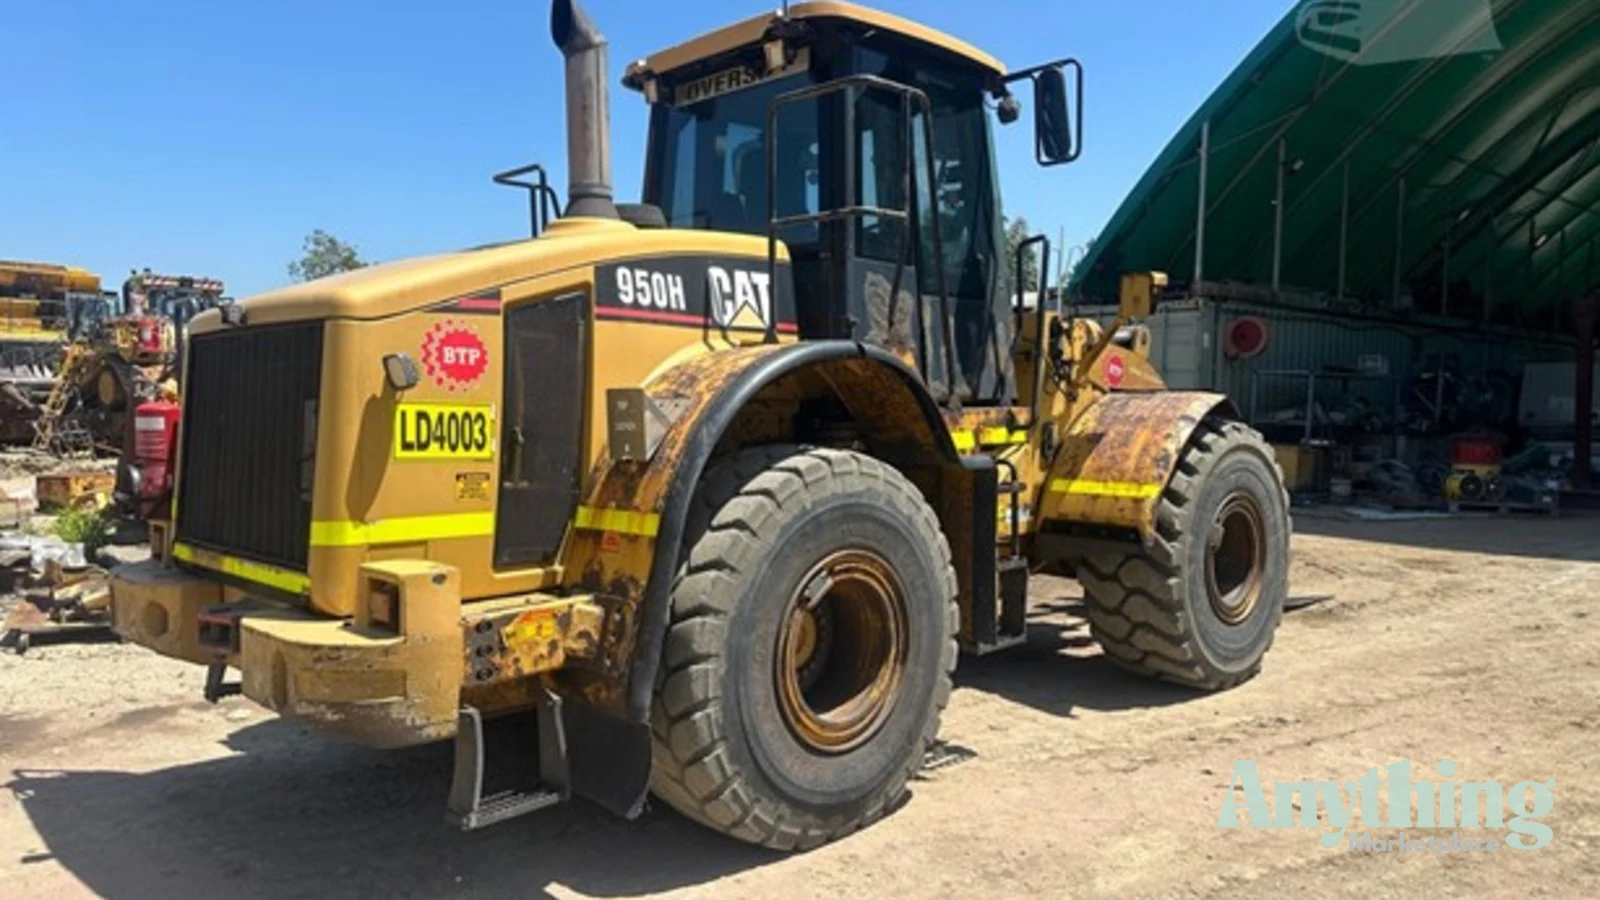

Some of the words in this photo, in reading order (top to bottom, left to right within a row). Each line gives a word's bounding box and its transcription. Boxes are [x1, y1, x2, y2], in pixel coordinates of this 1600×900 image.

[616, 266, 686, 311] 950H
[708, 266, 770, 329] CAT
[443, 346, 480, 365] BTP
[400, 410, 487, 452] LD4003
